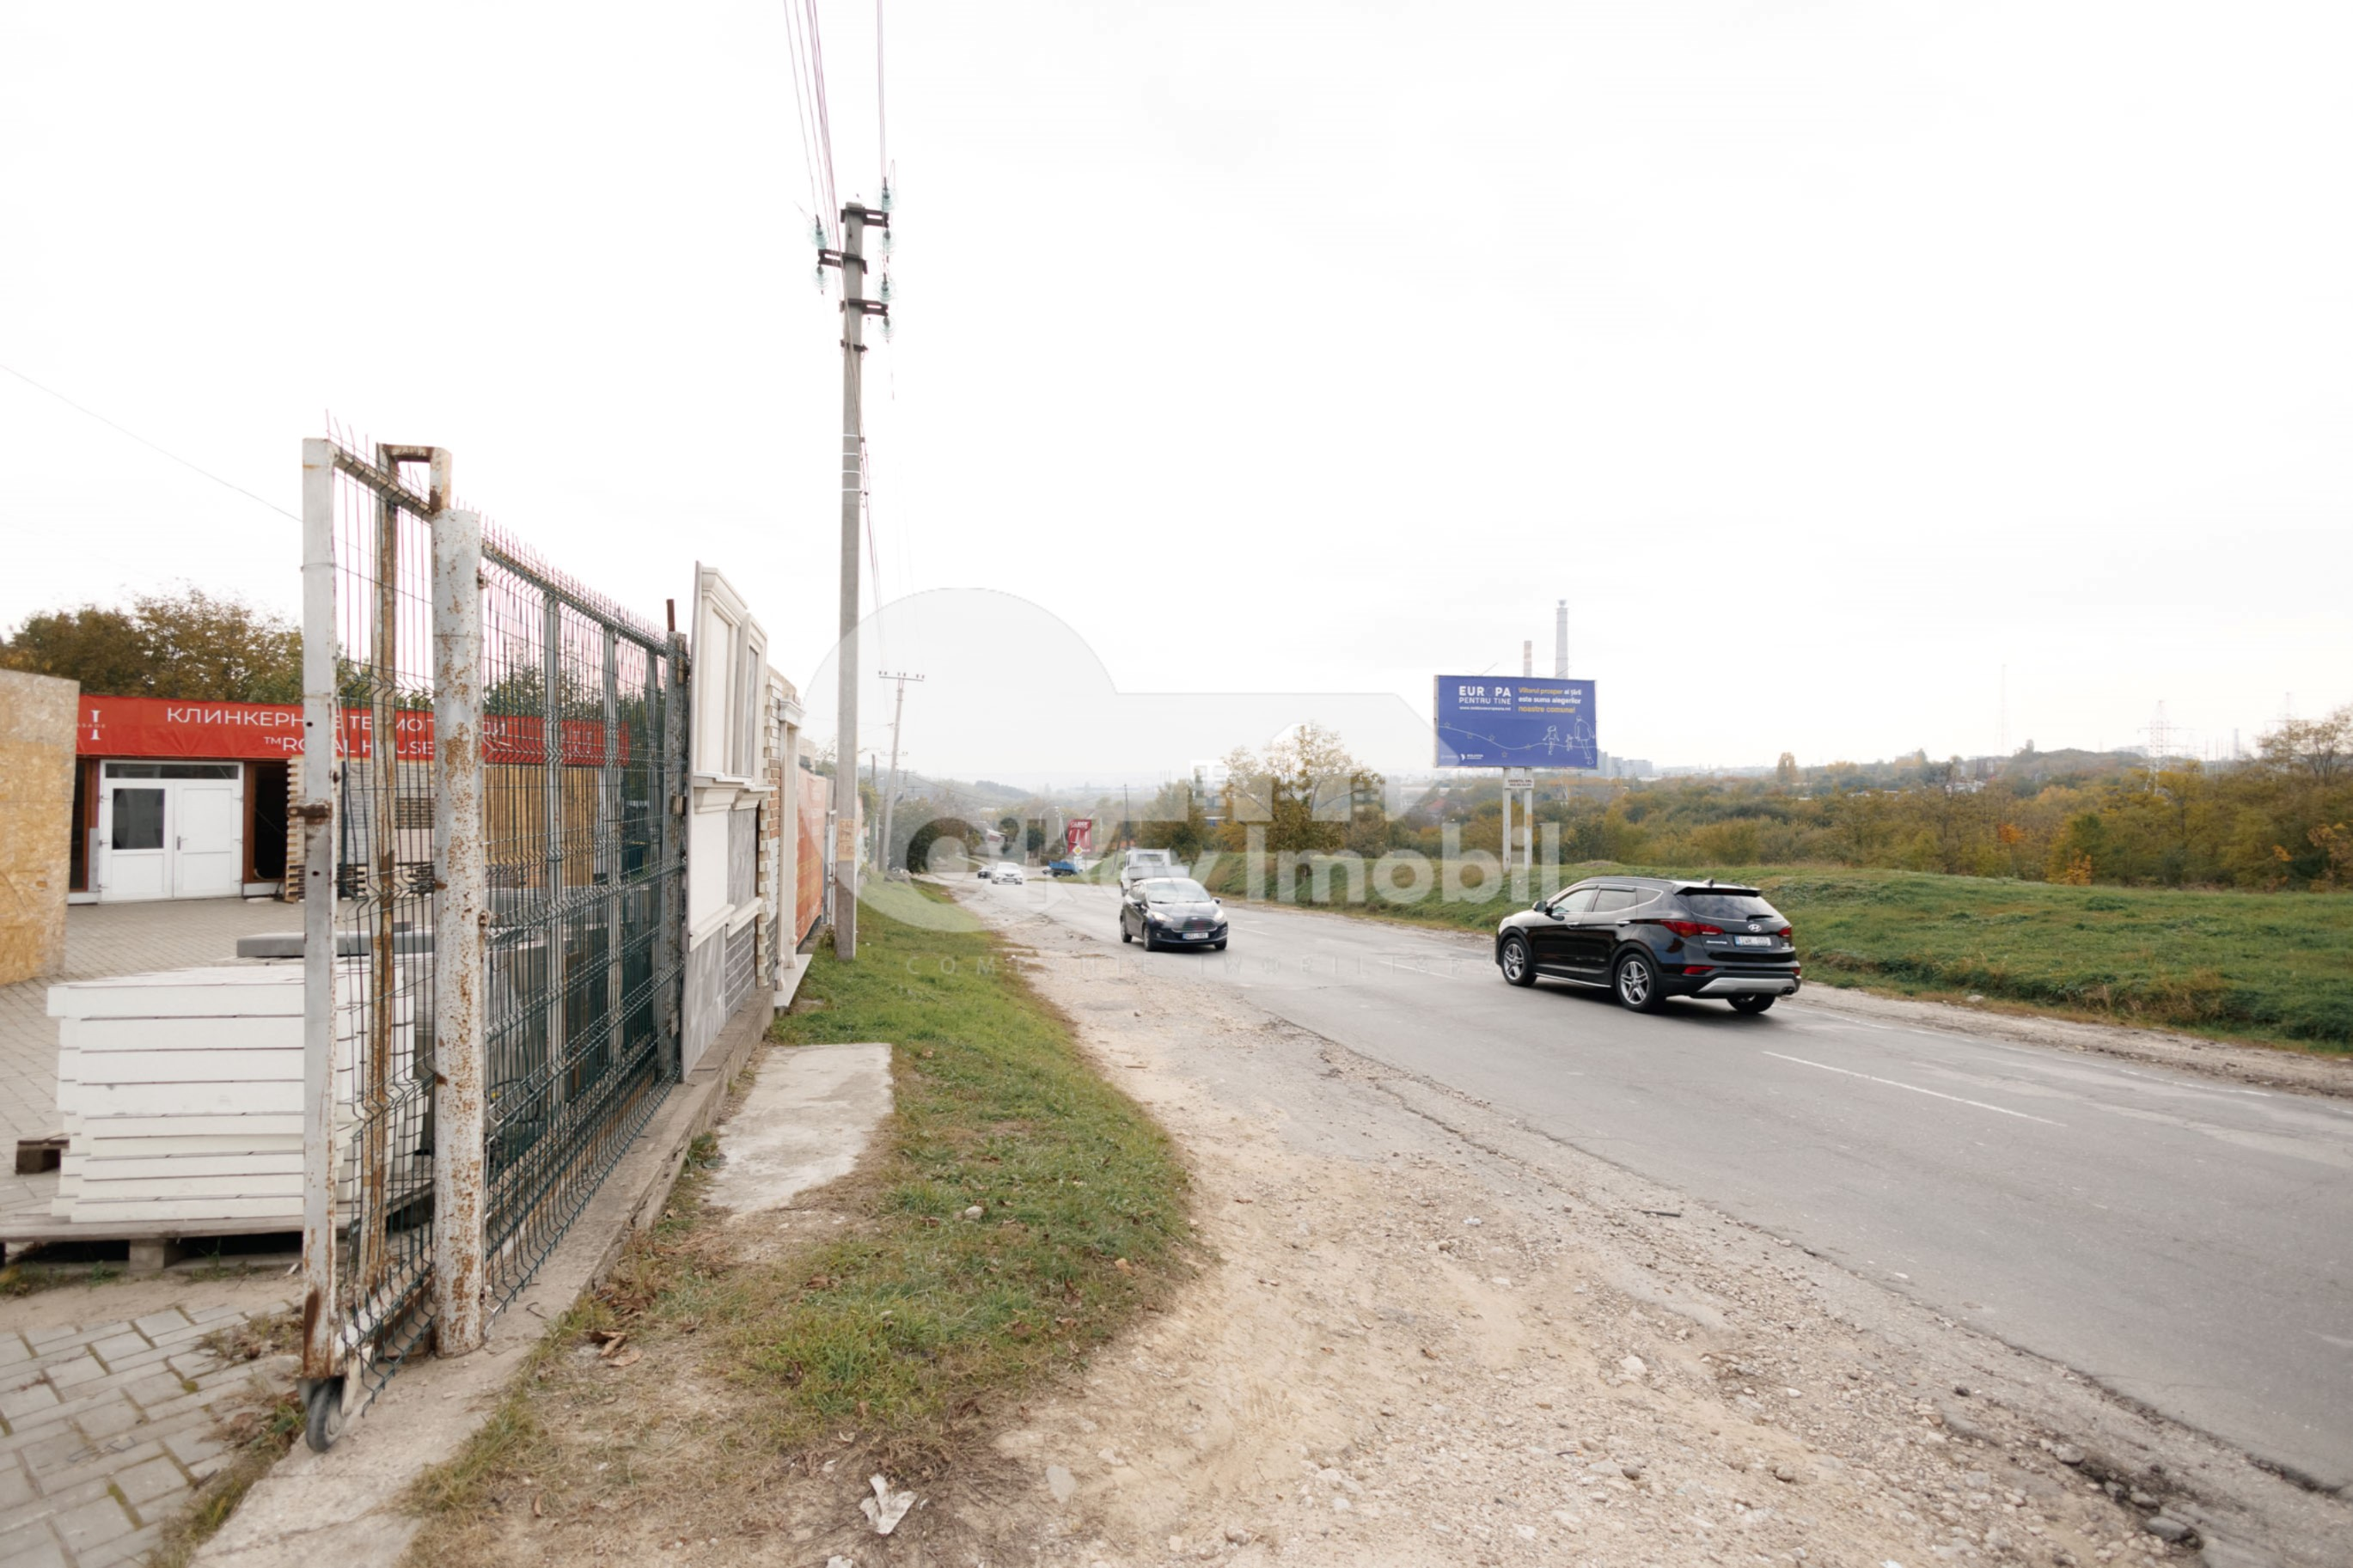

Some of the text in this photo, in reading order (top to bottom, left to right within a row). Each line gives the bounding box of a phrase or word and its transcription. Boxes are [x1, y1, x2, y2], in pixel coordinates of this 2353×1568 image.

[1458, 686, 1512, 697] EURPA
[167, 708, 341, 729] КЛИНКЕРНЕ
[363, 740, 433, 754] HUSE
